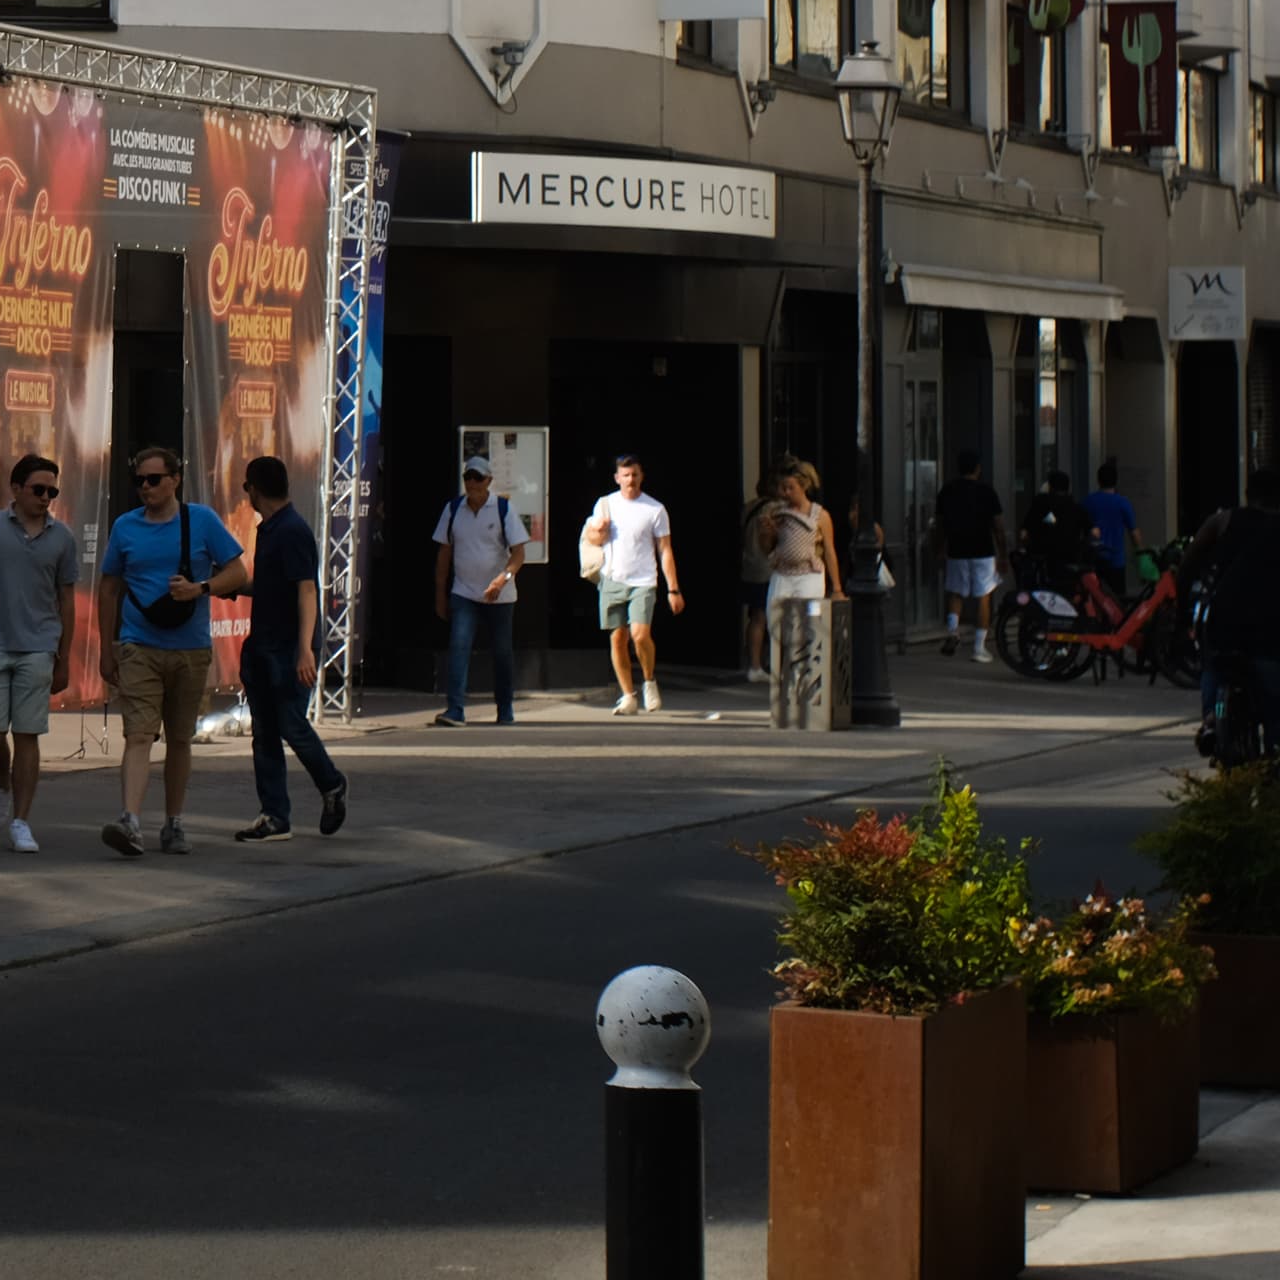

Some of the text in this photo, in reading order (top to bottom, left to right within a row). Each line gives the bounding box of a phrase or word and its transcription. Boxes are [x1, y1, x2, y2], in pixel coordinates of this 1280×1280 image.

[110, 127, 195, 156] LA COMÉDIE MUSICALE
[113, 153, 128, 167] AVEC
[138, 155, 152, 170] PLUS
[152, 157, 176, 173] GRANDS
[118, 176, 151, 202] DISCO
[152, 179, 181, 205] FUNK
[497, 171, 770, 220] MERCURE HOTEL
[208, 186, 308, 317] Inferno
[48, 302, 73, 329] NUIT
[271, 316, 292, 341] NUIT
[16, 327, 51, 355] DISCO
[244, 341, 274, 366] DISCO
[9, 379, 50, 404] LE MUSICAL
[240, 389, 248, 408] LE
